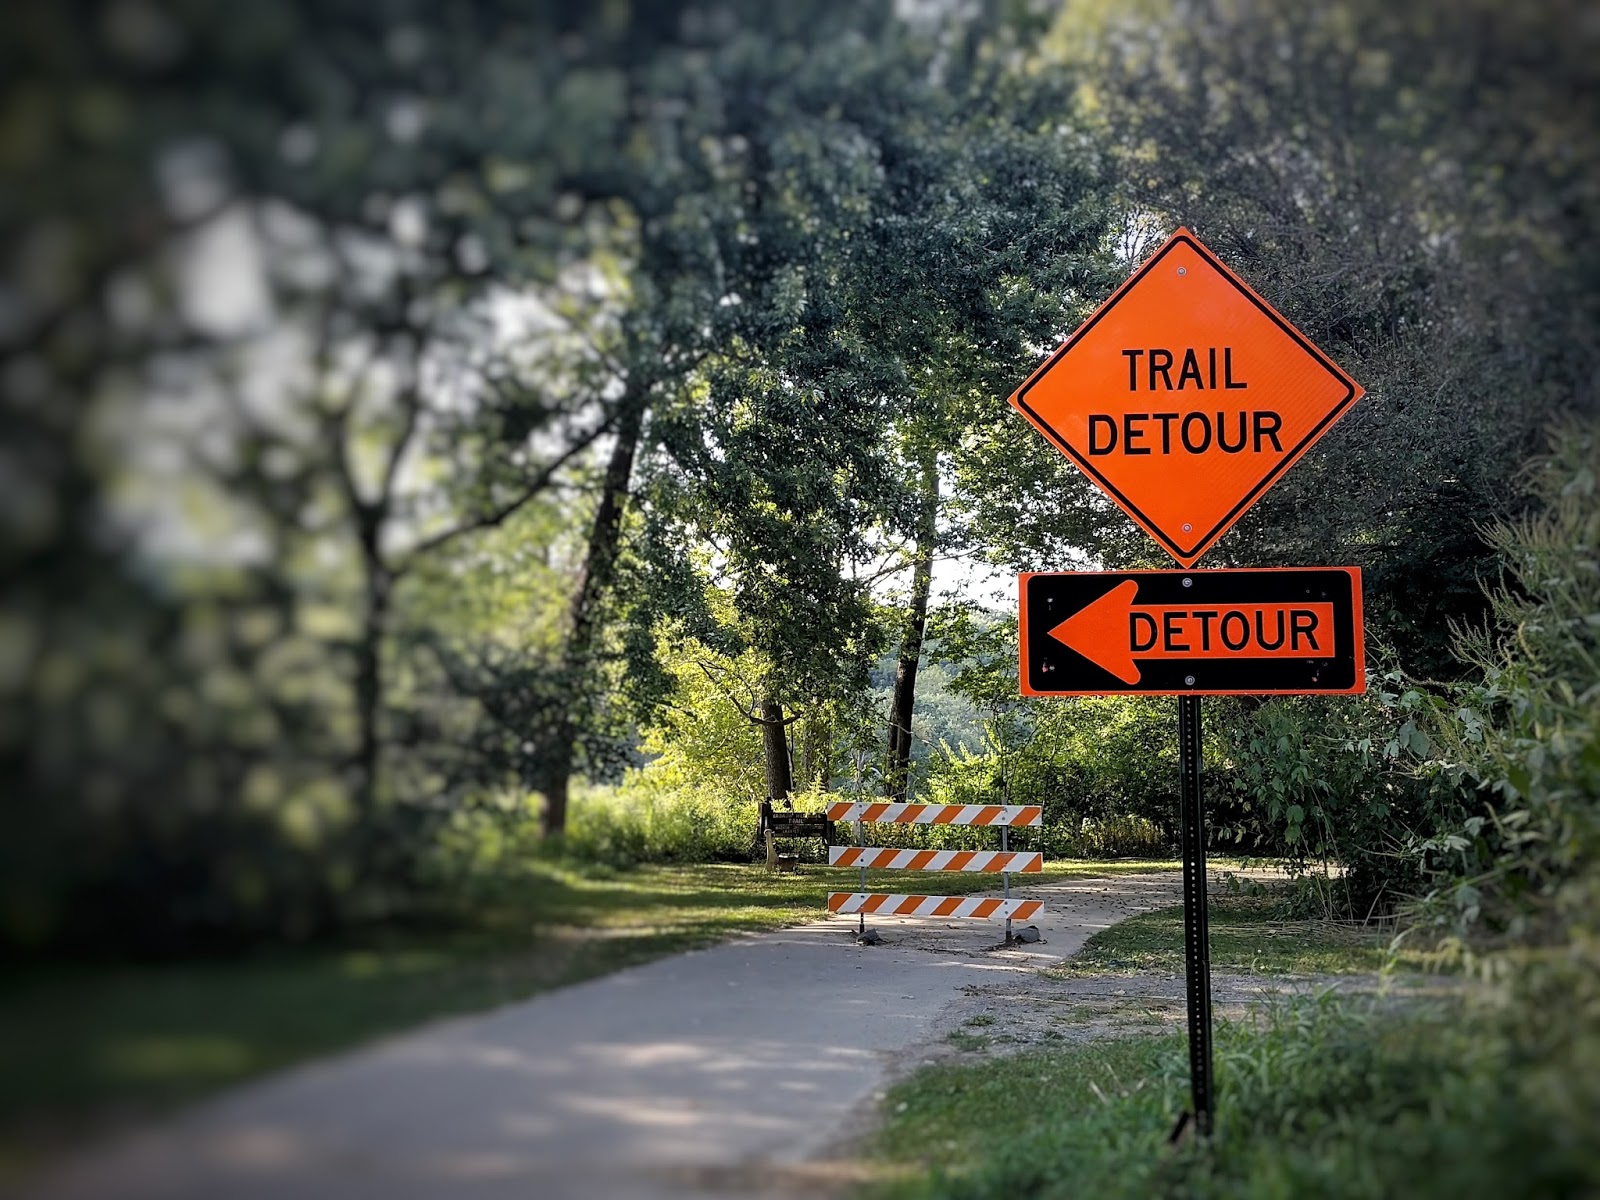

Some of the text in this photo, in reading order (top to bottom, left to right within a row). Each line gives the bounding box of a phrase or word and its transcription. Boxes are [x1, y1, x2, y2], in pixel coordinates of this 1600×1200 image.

[1122, 348, 1247, 391] TRAIL
[1088, 411, 1283, 456] DETOUR
[1130, 610, 1320, 652] DETOUR
